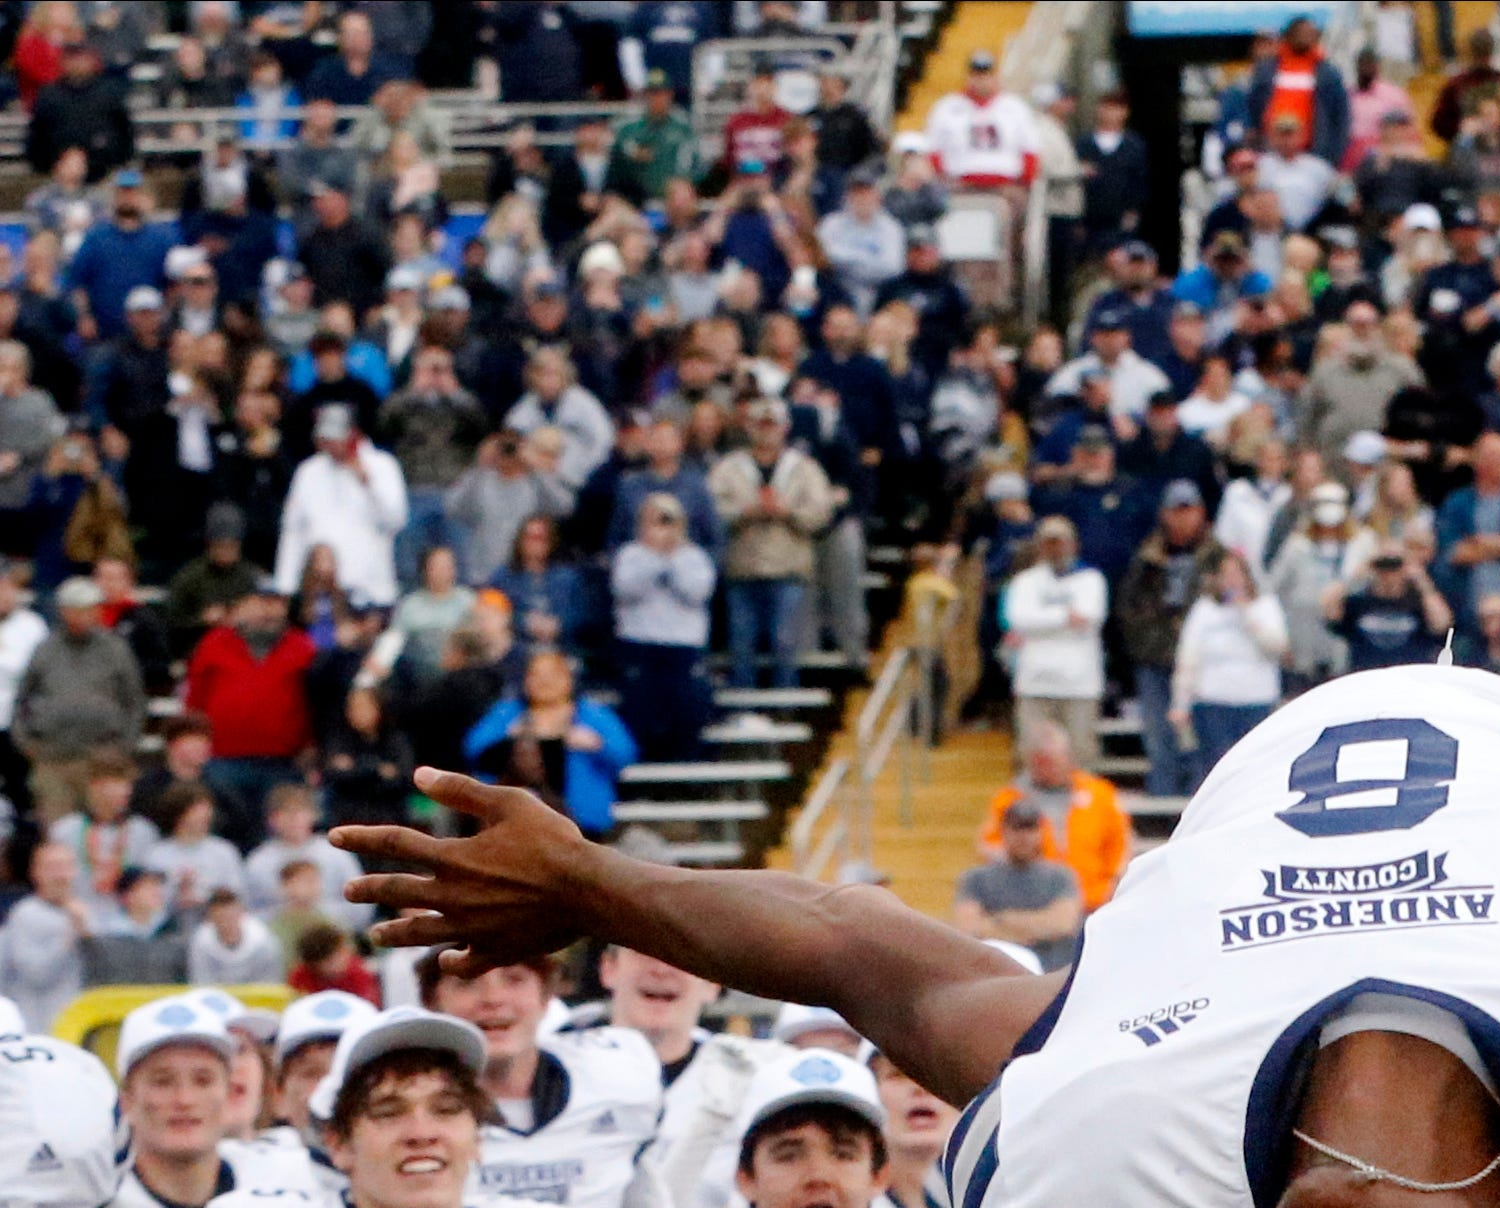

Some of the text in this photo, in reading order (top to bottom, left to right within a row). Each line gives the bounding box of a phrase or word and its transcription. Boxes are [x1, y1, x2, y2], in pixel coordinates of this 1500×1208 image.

[1274, 718, 1460, 838] 8
[1291, 857, 1419, 892] COUNTY
[1221, 892, 1495, 946] ANDERSON
[1118, 996, 1210, 1033] adidas
